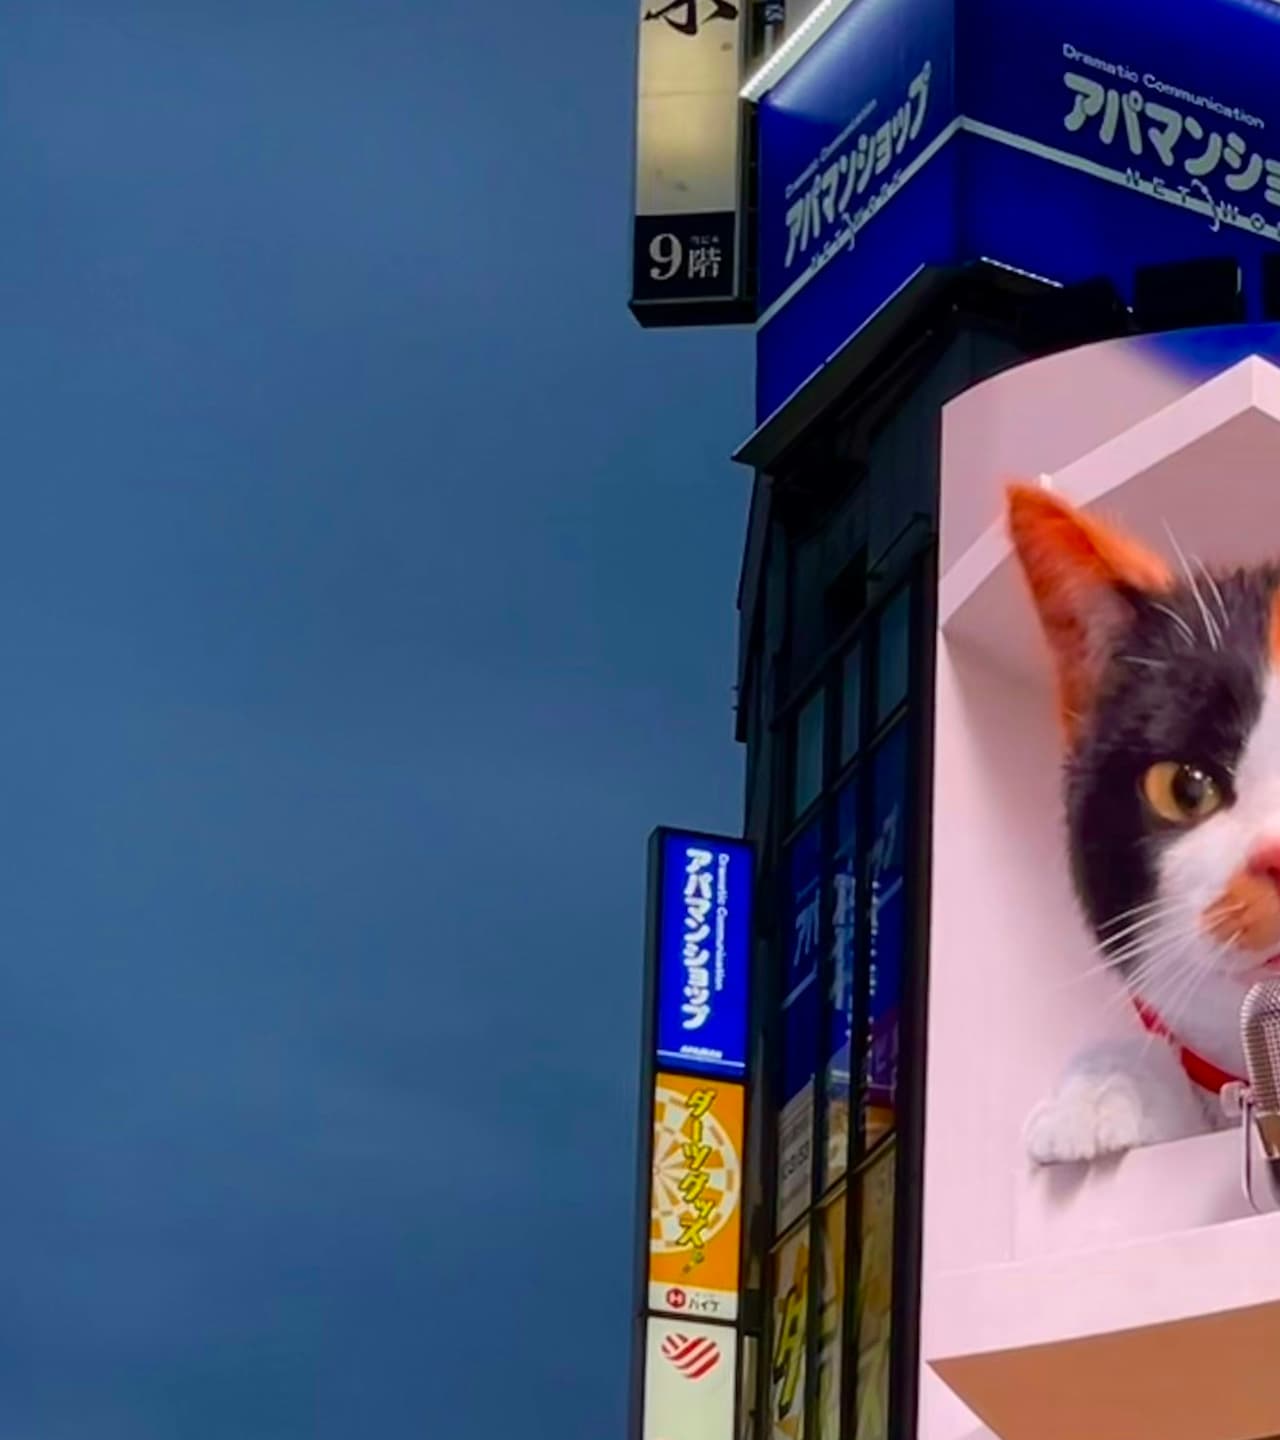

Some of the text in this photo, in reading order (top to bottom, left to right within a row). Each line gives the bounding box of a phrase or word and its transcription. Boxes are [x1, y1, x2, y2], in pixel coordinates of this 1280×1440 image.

[1062, 42, 1265, 130] Dramatic Communication
[786, 60, 932, 268] アパマンショップ
[648, 232, 722, 281] 9階
[681, 847, 713, 1030] アパマンショップ
